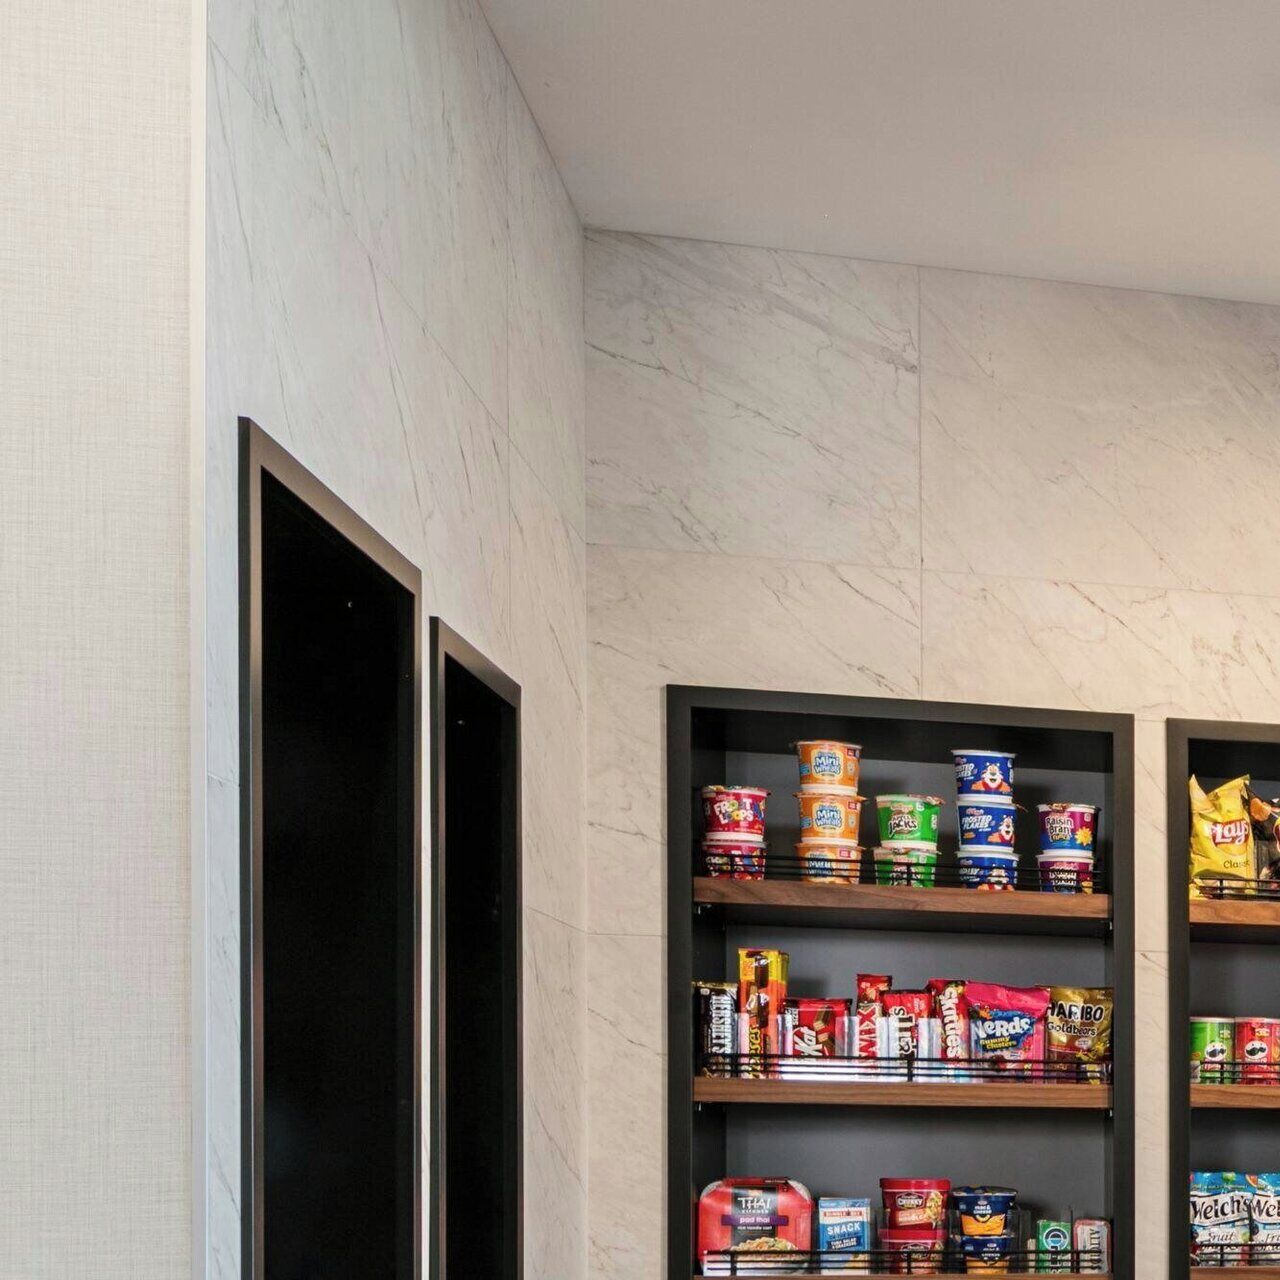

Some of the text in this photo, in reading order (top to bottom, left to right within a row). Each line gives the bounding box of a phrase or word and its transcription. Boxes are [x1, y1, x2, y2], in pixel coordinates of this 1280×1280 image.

[888, 817, 919, 832] JACKS
[1046, 816, 1074, 828] Raisin
[1048, 825, 1070, 835] Bran
[1047, 1000, 1104, 1023] HARIBO
[710, 995, 732, 1054] HERSHEY'S
[939, 987, 960, 1058] Skittles
[975, 1016, 1032, 1038] Nerds
[737, 1197, 771, 1210] THAI
[1190, 1196, 1250, 1221] Welch's
[739, 1216, 771, 1225] pad thai
[826, 1221, 862, 1236] SNACK
